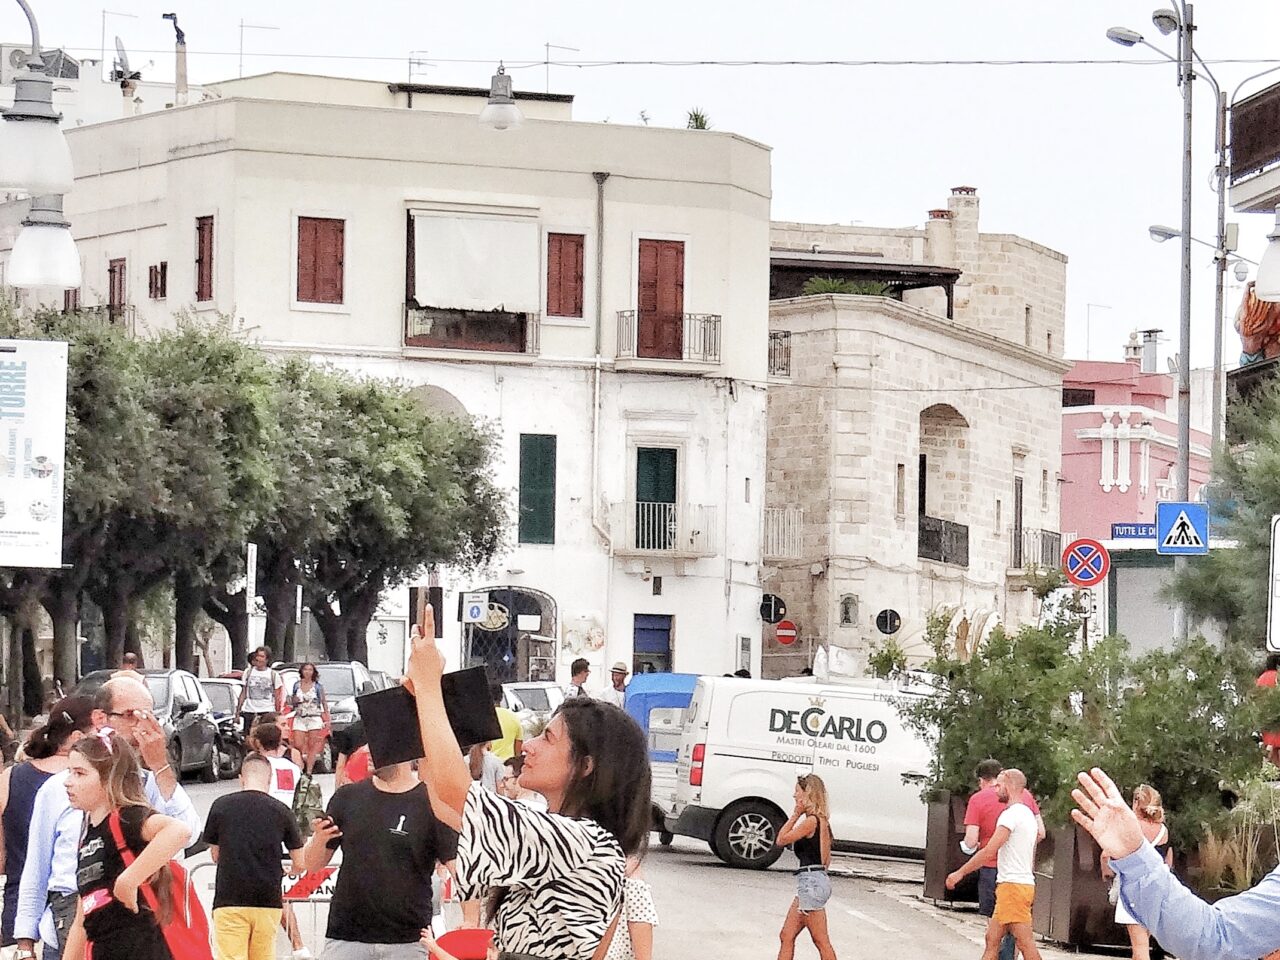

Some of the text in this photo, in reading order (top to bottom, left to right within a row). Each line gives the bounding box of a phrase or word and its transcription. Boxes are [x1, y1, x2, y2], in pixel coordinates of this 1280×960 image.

[0, 361, 27, 420] TORRE
[1114, 526, 1137, 536] TUTTE
[1138, 526, 1148, 536] LE
[776, 736, 877, 755] MASTRI OLEARI DAL 1600
[771, 751, 880, 772] PRODOTTI TIPICI PUGLIESI
